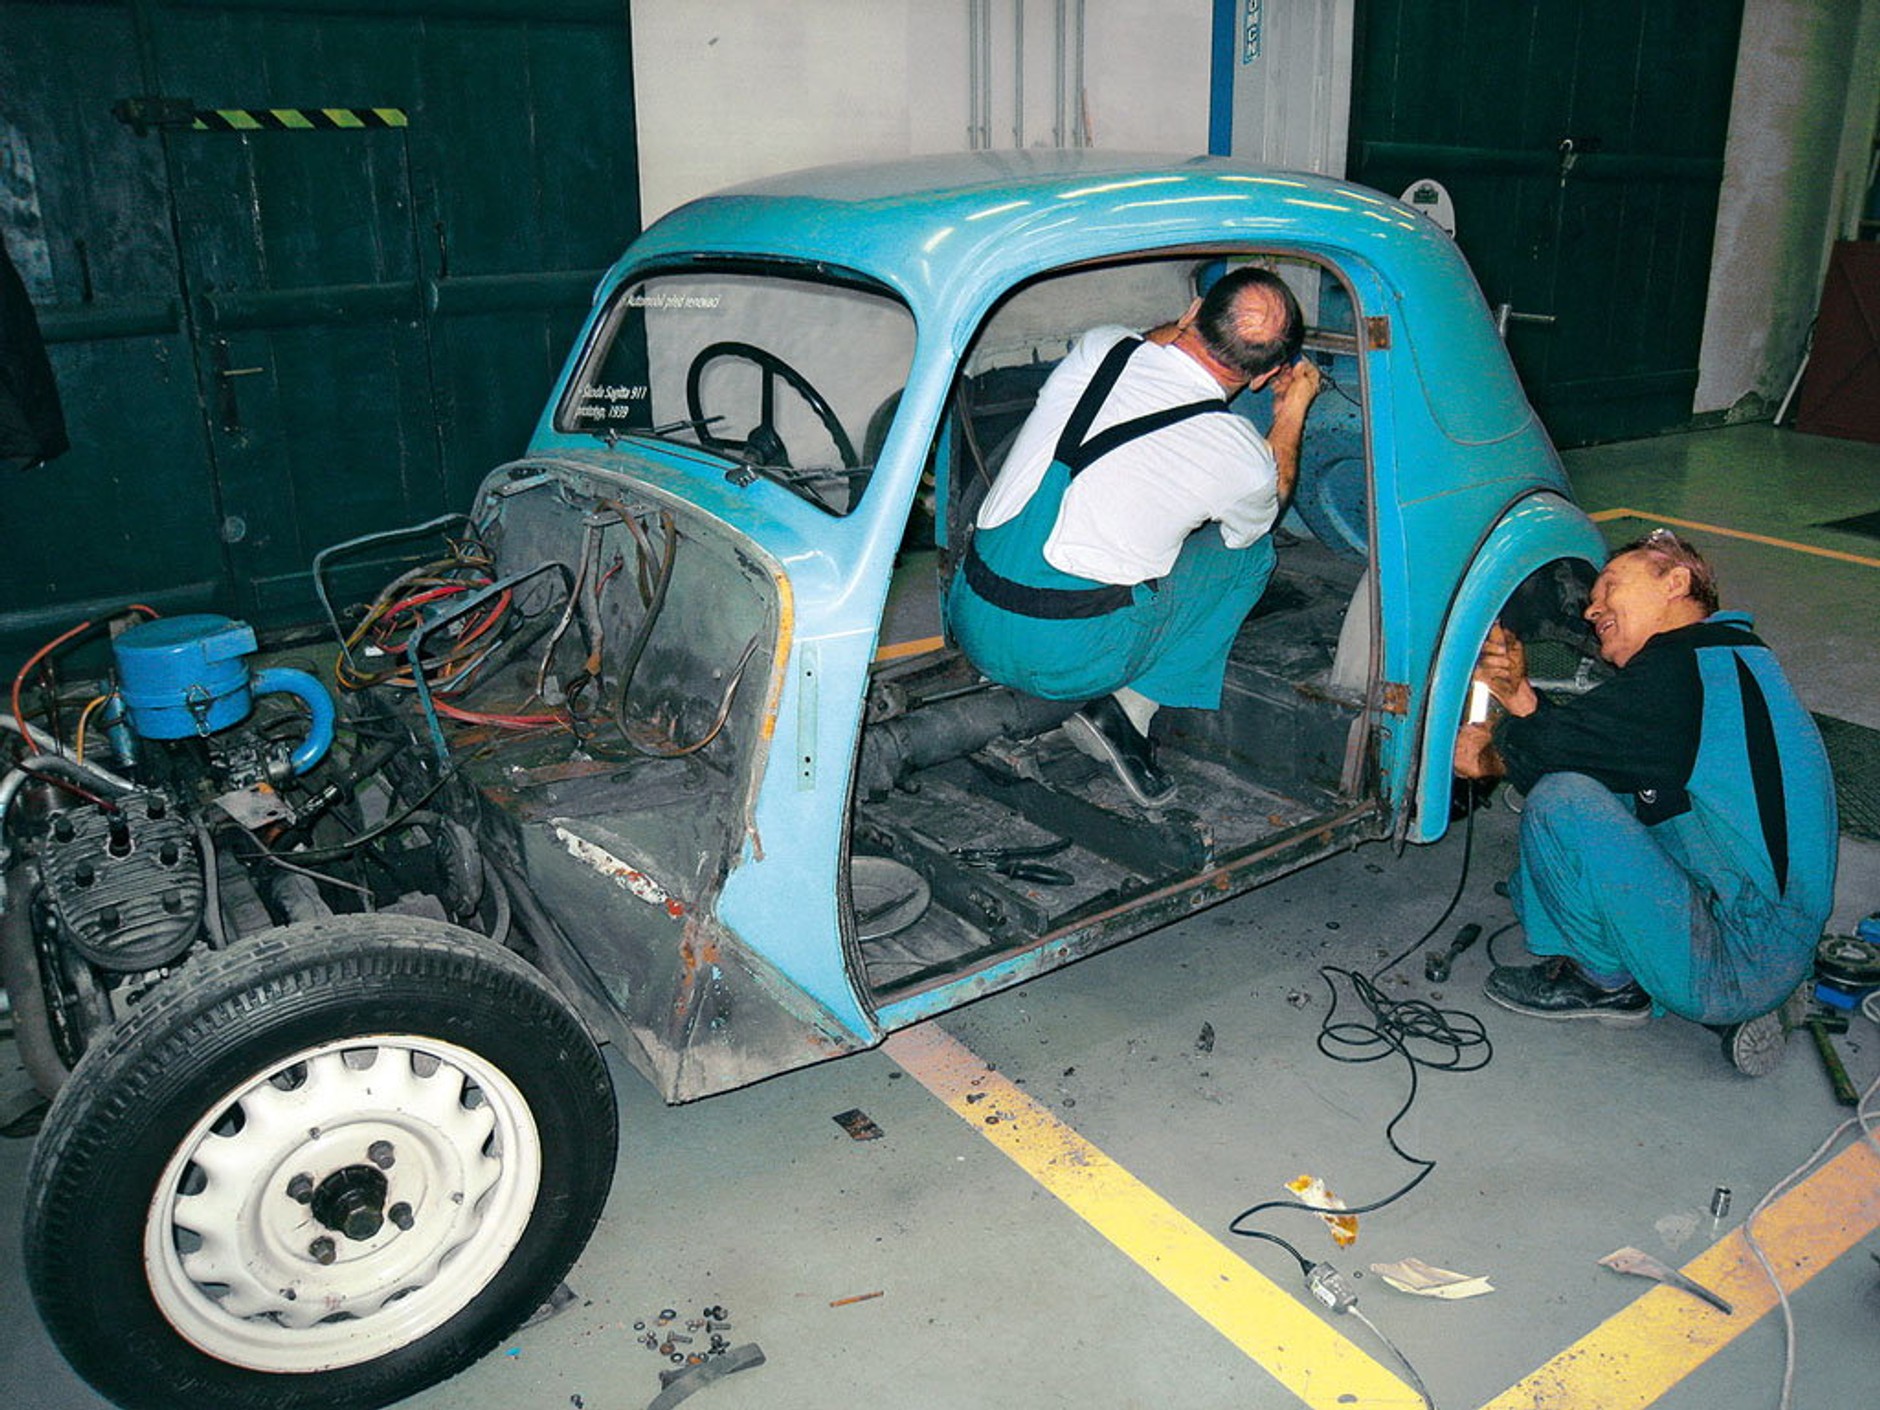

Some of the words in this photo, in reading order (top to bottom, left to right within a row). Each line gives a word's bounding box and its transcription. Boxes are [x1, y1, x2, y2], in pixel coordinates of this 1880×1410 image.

[604, 384, 631, 402] Sagitta
[630, 385, 648, 399] 911
[607, 403, 630, 418] 1939
